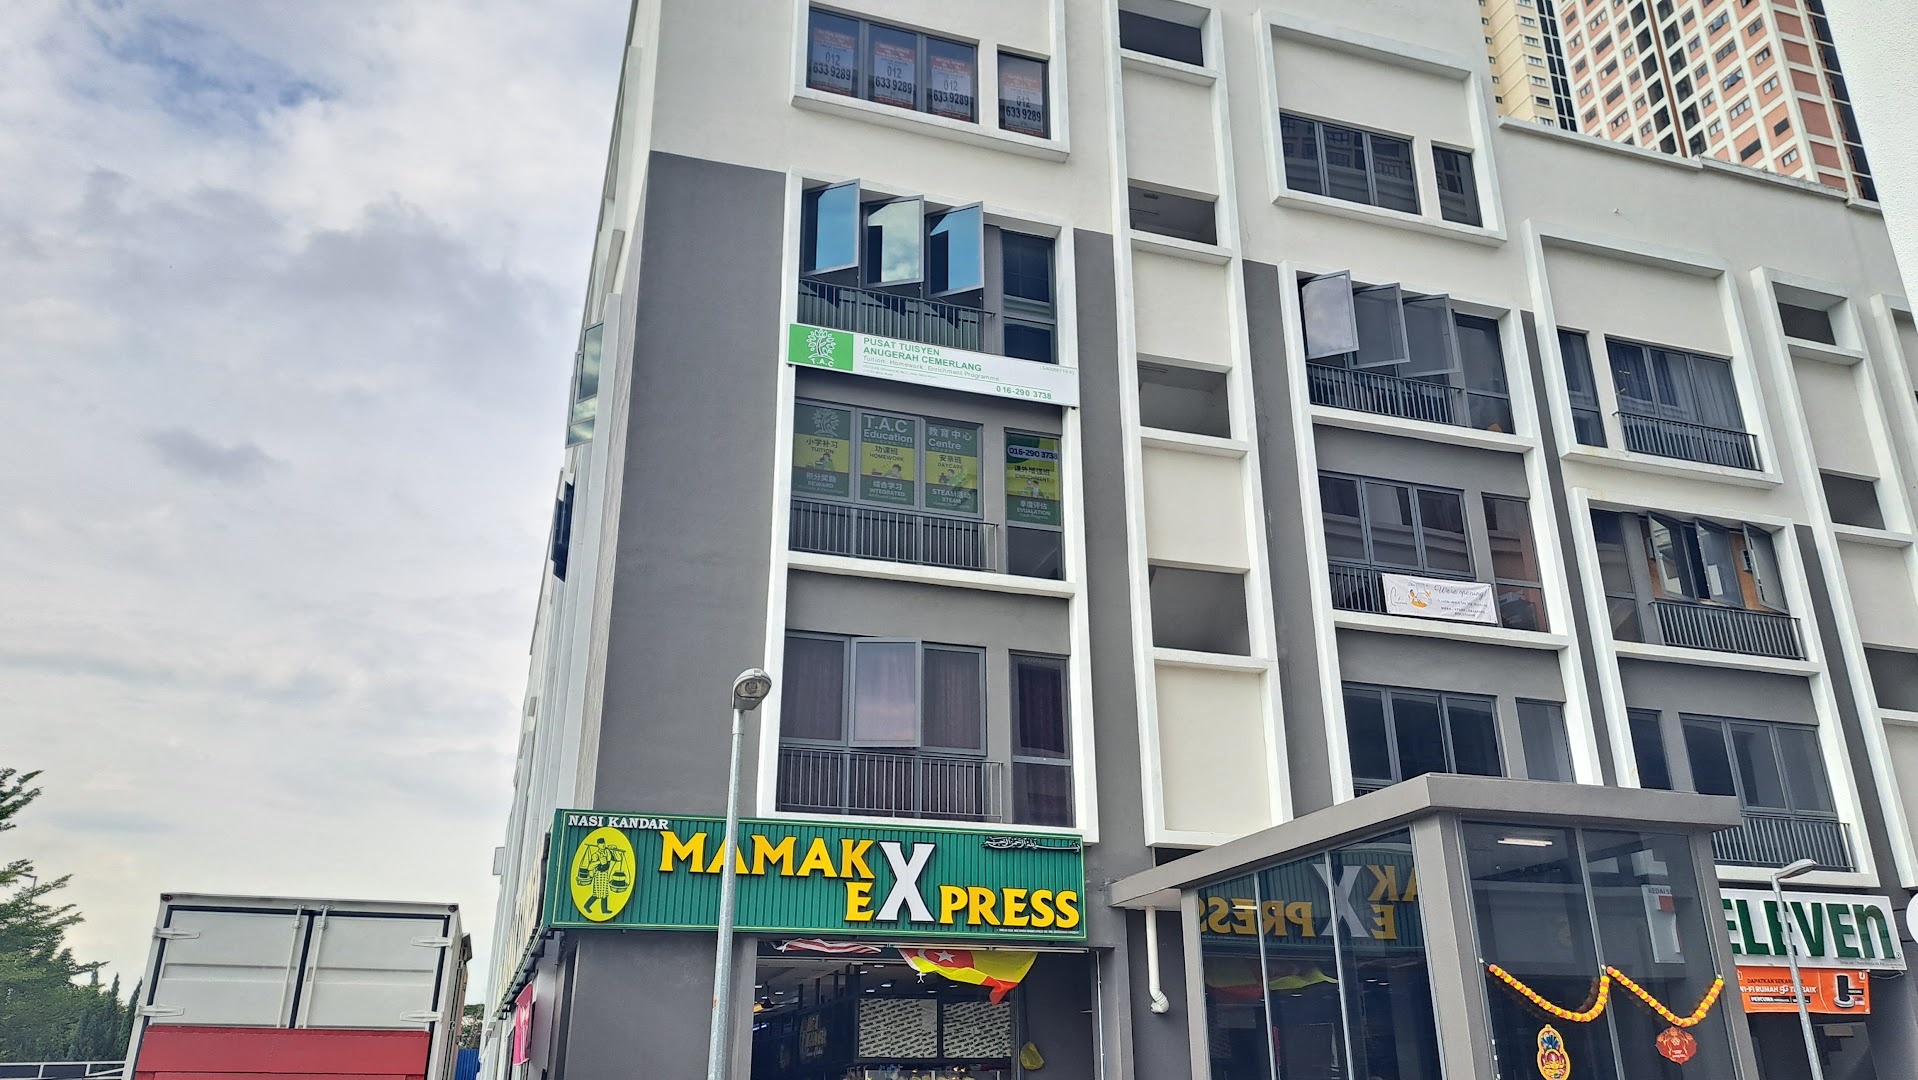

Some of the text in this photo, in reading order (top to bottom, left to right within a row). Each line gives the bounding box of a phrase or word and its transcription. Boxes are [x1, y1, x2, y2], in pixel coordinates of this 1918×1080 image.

[825, 51, 841, 66] 012
[813, 62, 851, 81] 633 9289
[886, 65, 902, 78] 012
[875, 76, 913, 94] 633 9289
[943, 79, 958, 91] 012
[933, 89, 969, 106] 633 9289
[1016, 95, 1031, 108] 012
[1005, 106, 1041, 122] 633 9289
[863, 337, 940, 356] PUSAT TUISYEN
[811, 358, 834, 367] T.A.C
[863, 346, 919, 362] ANUGERAH
[921, 355, 982, 372] CEMERLANG
[863, 355, 885, 363] Tuition
[889, 359, 923, 370] Homework
[927, 365, 963, 376] Enrichment
[964, 370, 1000, 381] Programme
[996, 385, 1052, 400] 016-290 3738
[863, 414, 908, 433] T.A.C
[863, 429, 913, 444] Education
[928, 427, 972, 441] 教育中心
[805, 437, 838, 449] 小学补习
[811, 446, 835, 454] TUITION
[928, 438, 962, 450] Centre
[869, 453, 904, 462] HOMEWORK
[874, 445, 899, 456] 功课班
[1008, 446, 1059, 460] 016-290 3738
[937, 462, 963, 471] DAYCARE
[807, 480, 834, 489] REWARD
[869, 488, 906, 497] INTEGRATED
[941, 496, 962, 504] STEAM
[568, 814, 669, 831] NASI KANDAR
[659, 831, 876, 879] MAMAK
